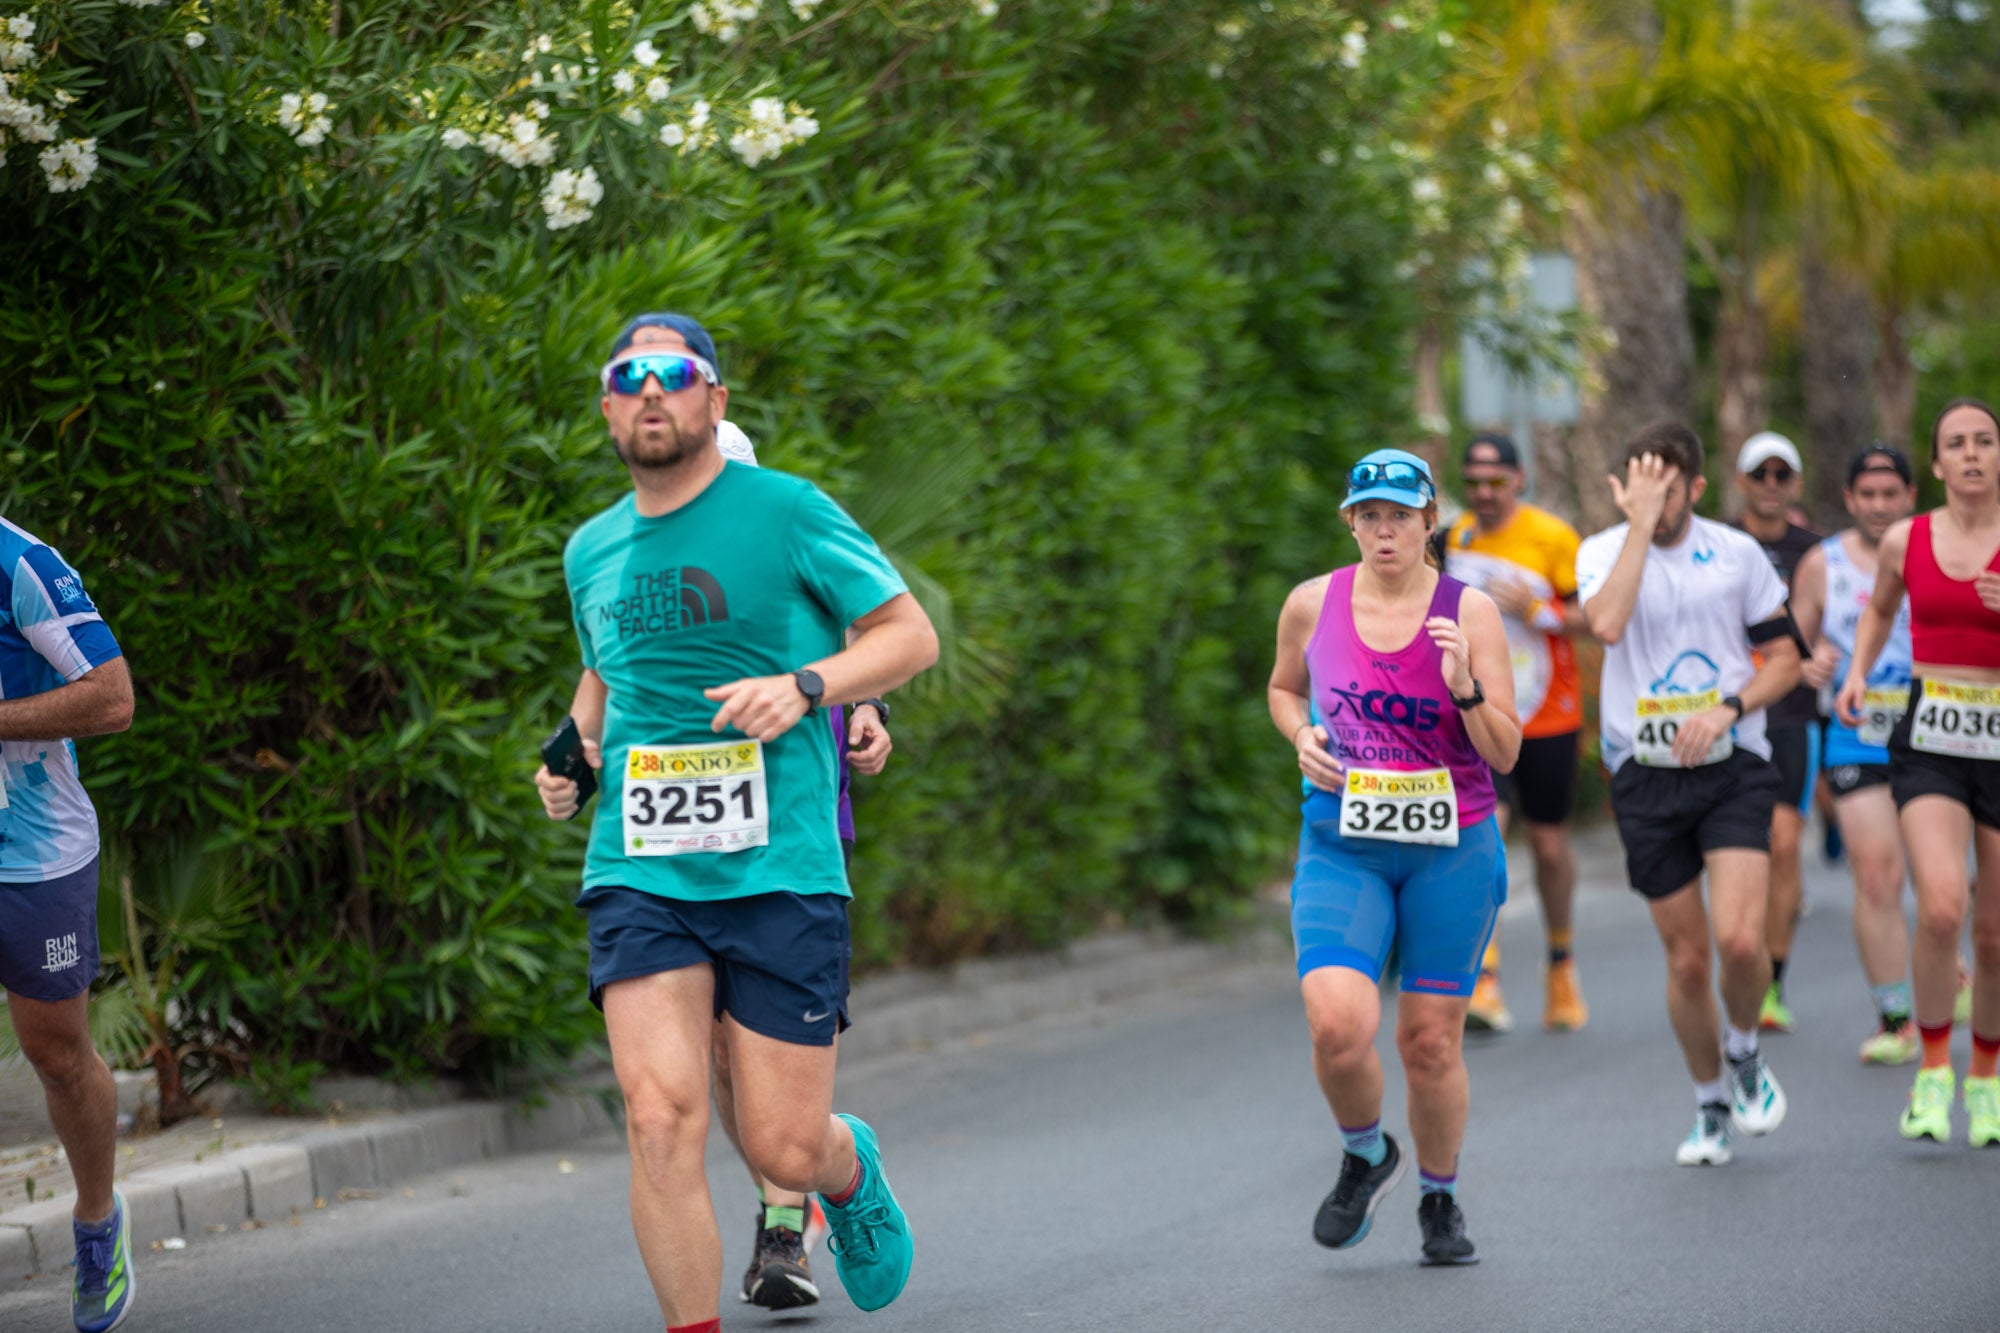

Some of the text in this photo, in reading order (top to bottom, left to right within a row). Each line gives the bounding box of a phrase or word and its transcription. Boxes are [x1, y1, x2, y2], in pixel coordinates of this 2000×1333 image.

[54, 574, 74, 590] RUN
[633, 568, 677, 594] THE
[599, 588, 678, 625] NORTH
[618, 610, 678, 640] FACE
[1920, 705, 2000, 738] 4036
[641, 754, 731, 773] 38 FONDO
[1361, 776, 1378, 790] 38
[629, 779, 754, 827] 3251
[1346, 801, 1451, 833] 3269
[46, 932, 77, 953] RUN
[47, 945, 77, 967] RUN
